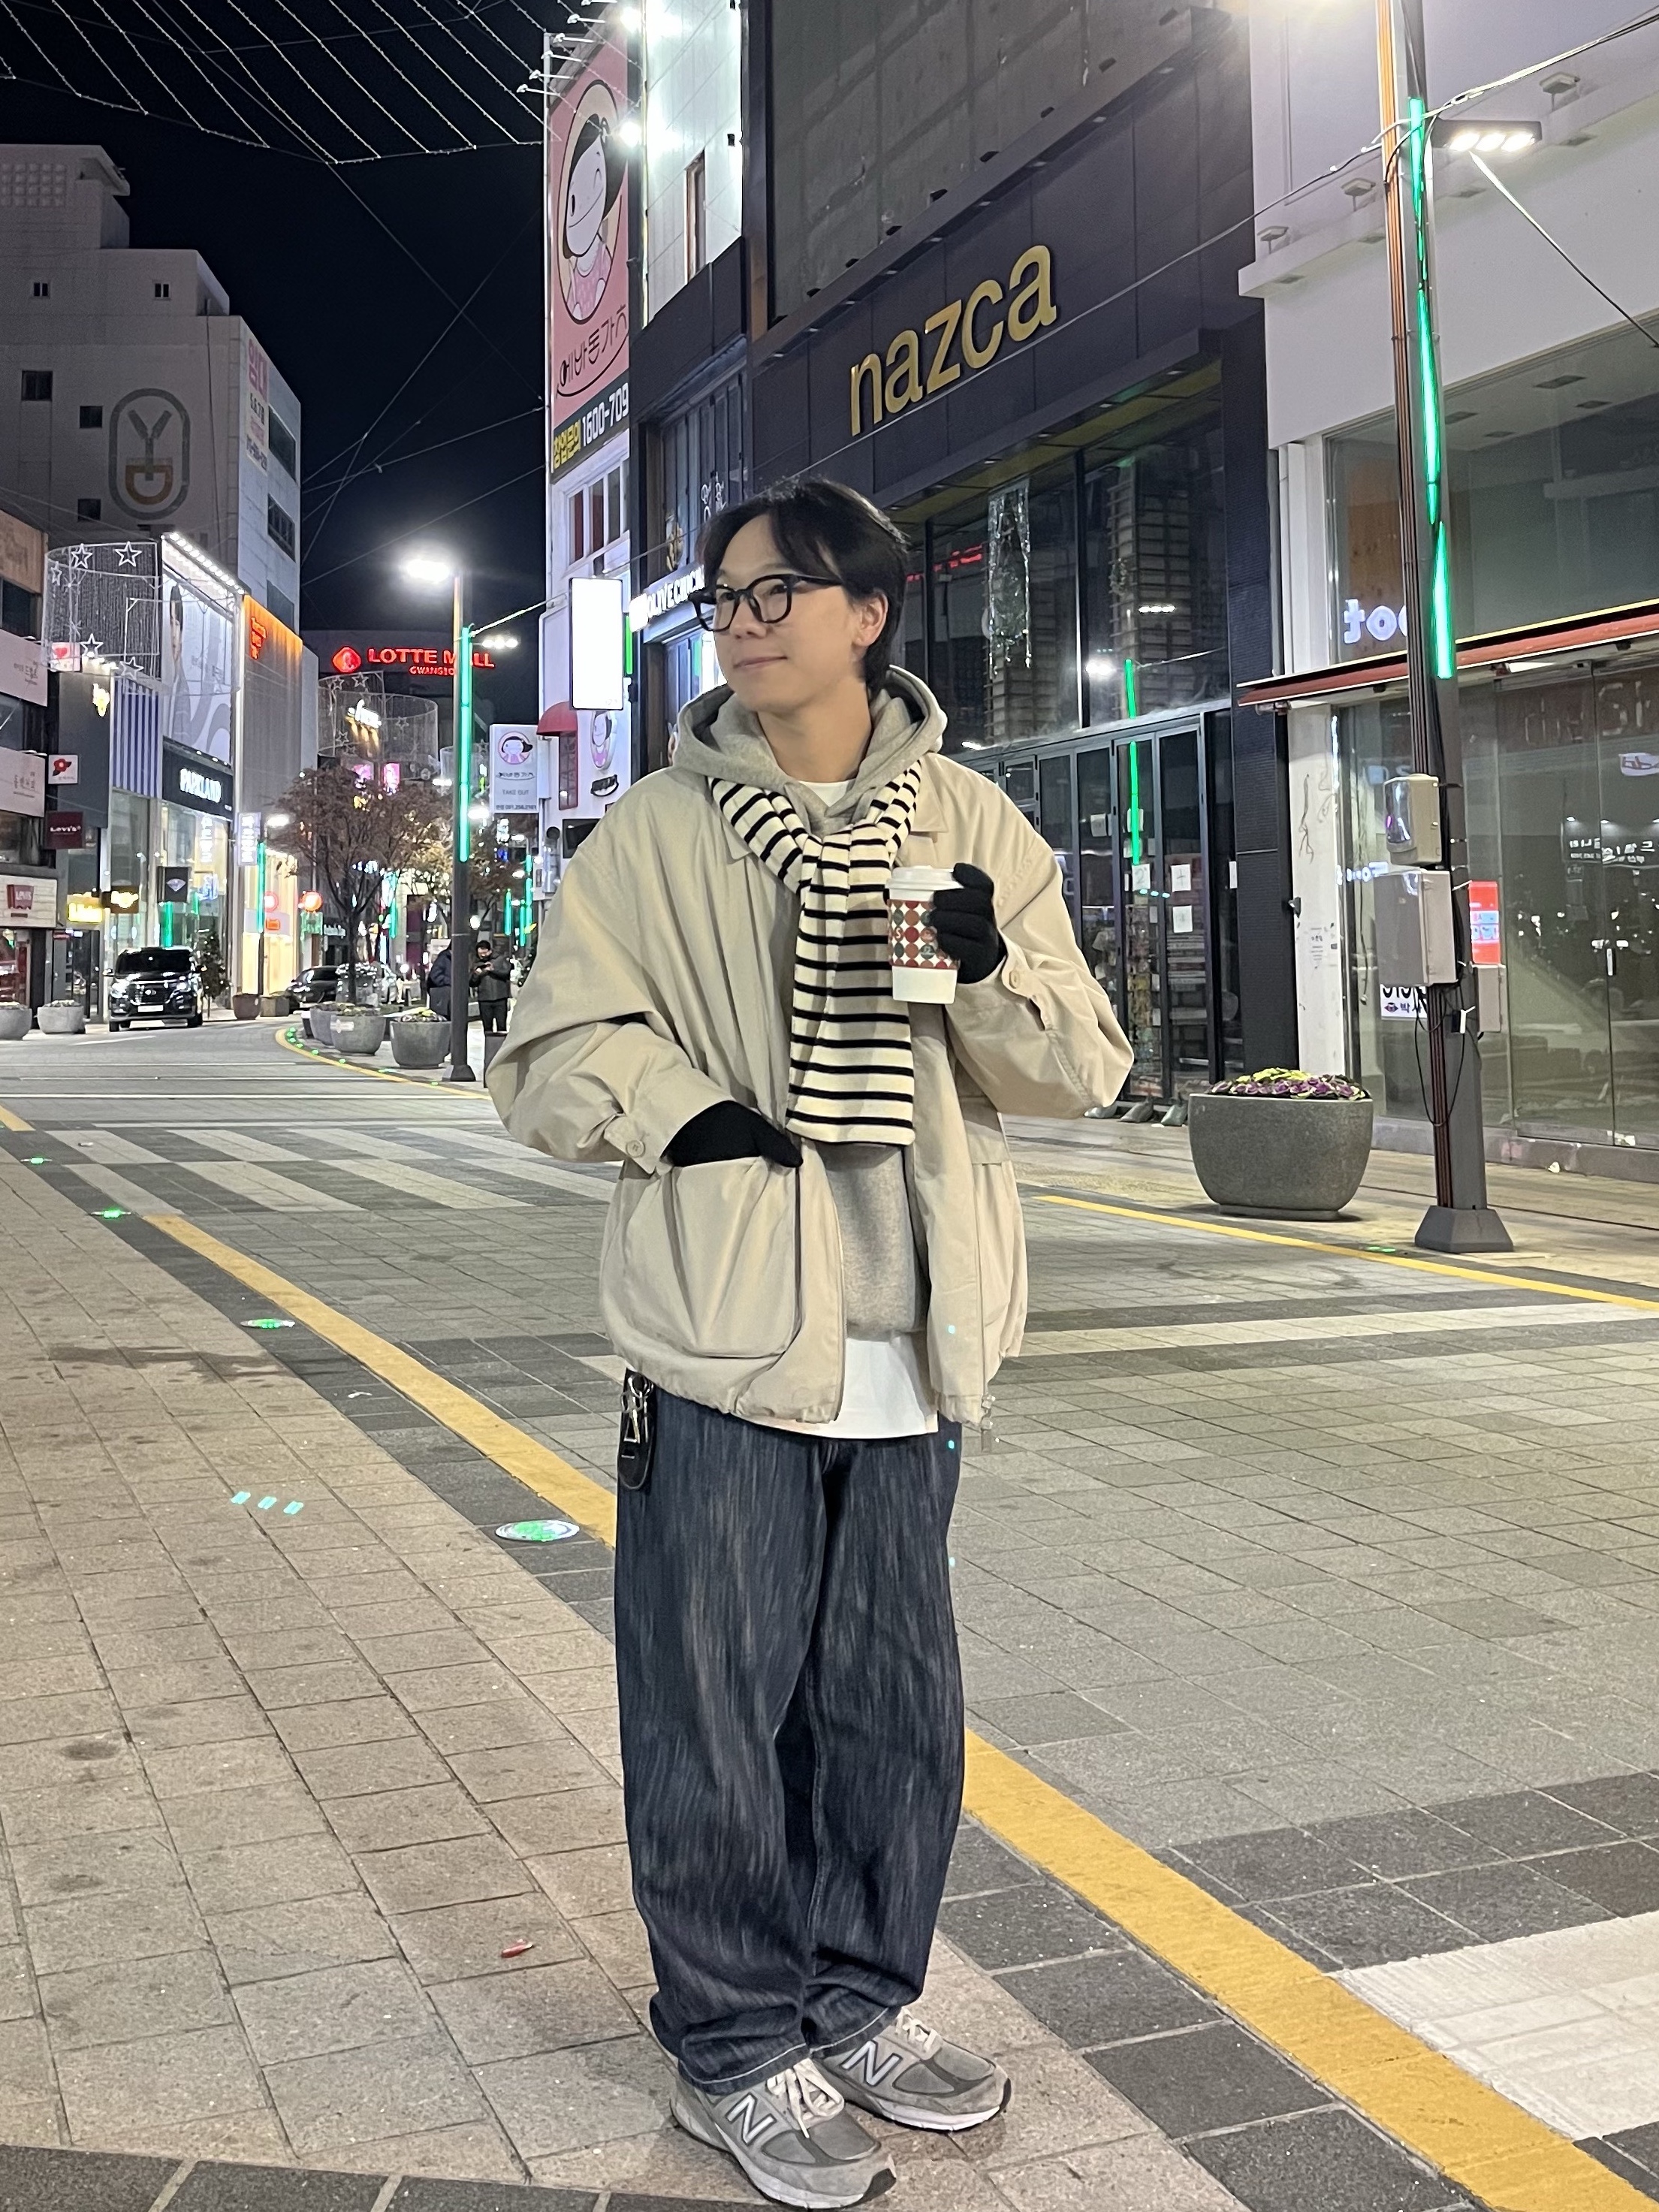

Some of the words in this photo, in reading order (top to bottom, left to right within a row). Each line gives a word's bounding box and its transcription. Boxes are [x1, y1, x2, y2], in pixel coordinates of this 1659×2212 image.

[851, 245, 1057, 436] nazca
[582, 382, 629, 447] 1600-709
[367, 647, 438, 664] LOTTE
[443, 650, 496, 668] MLL
[409, 665, 455, 676] GWANGBO
[179, 768, 222, 804] PARKLAND
[839, 2038, 903, 2087] N
[724, 2091, 778, 2146] N
